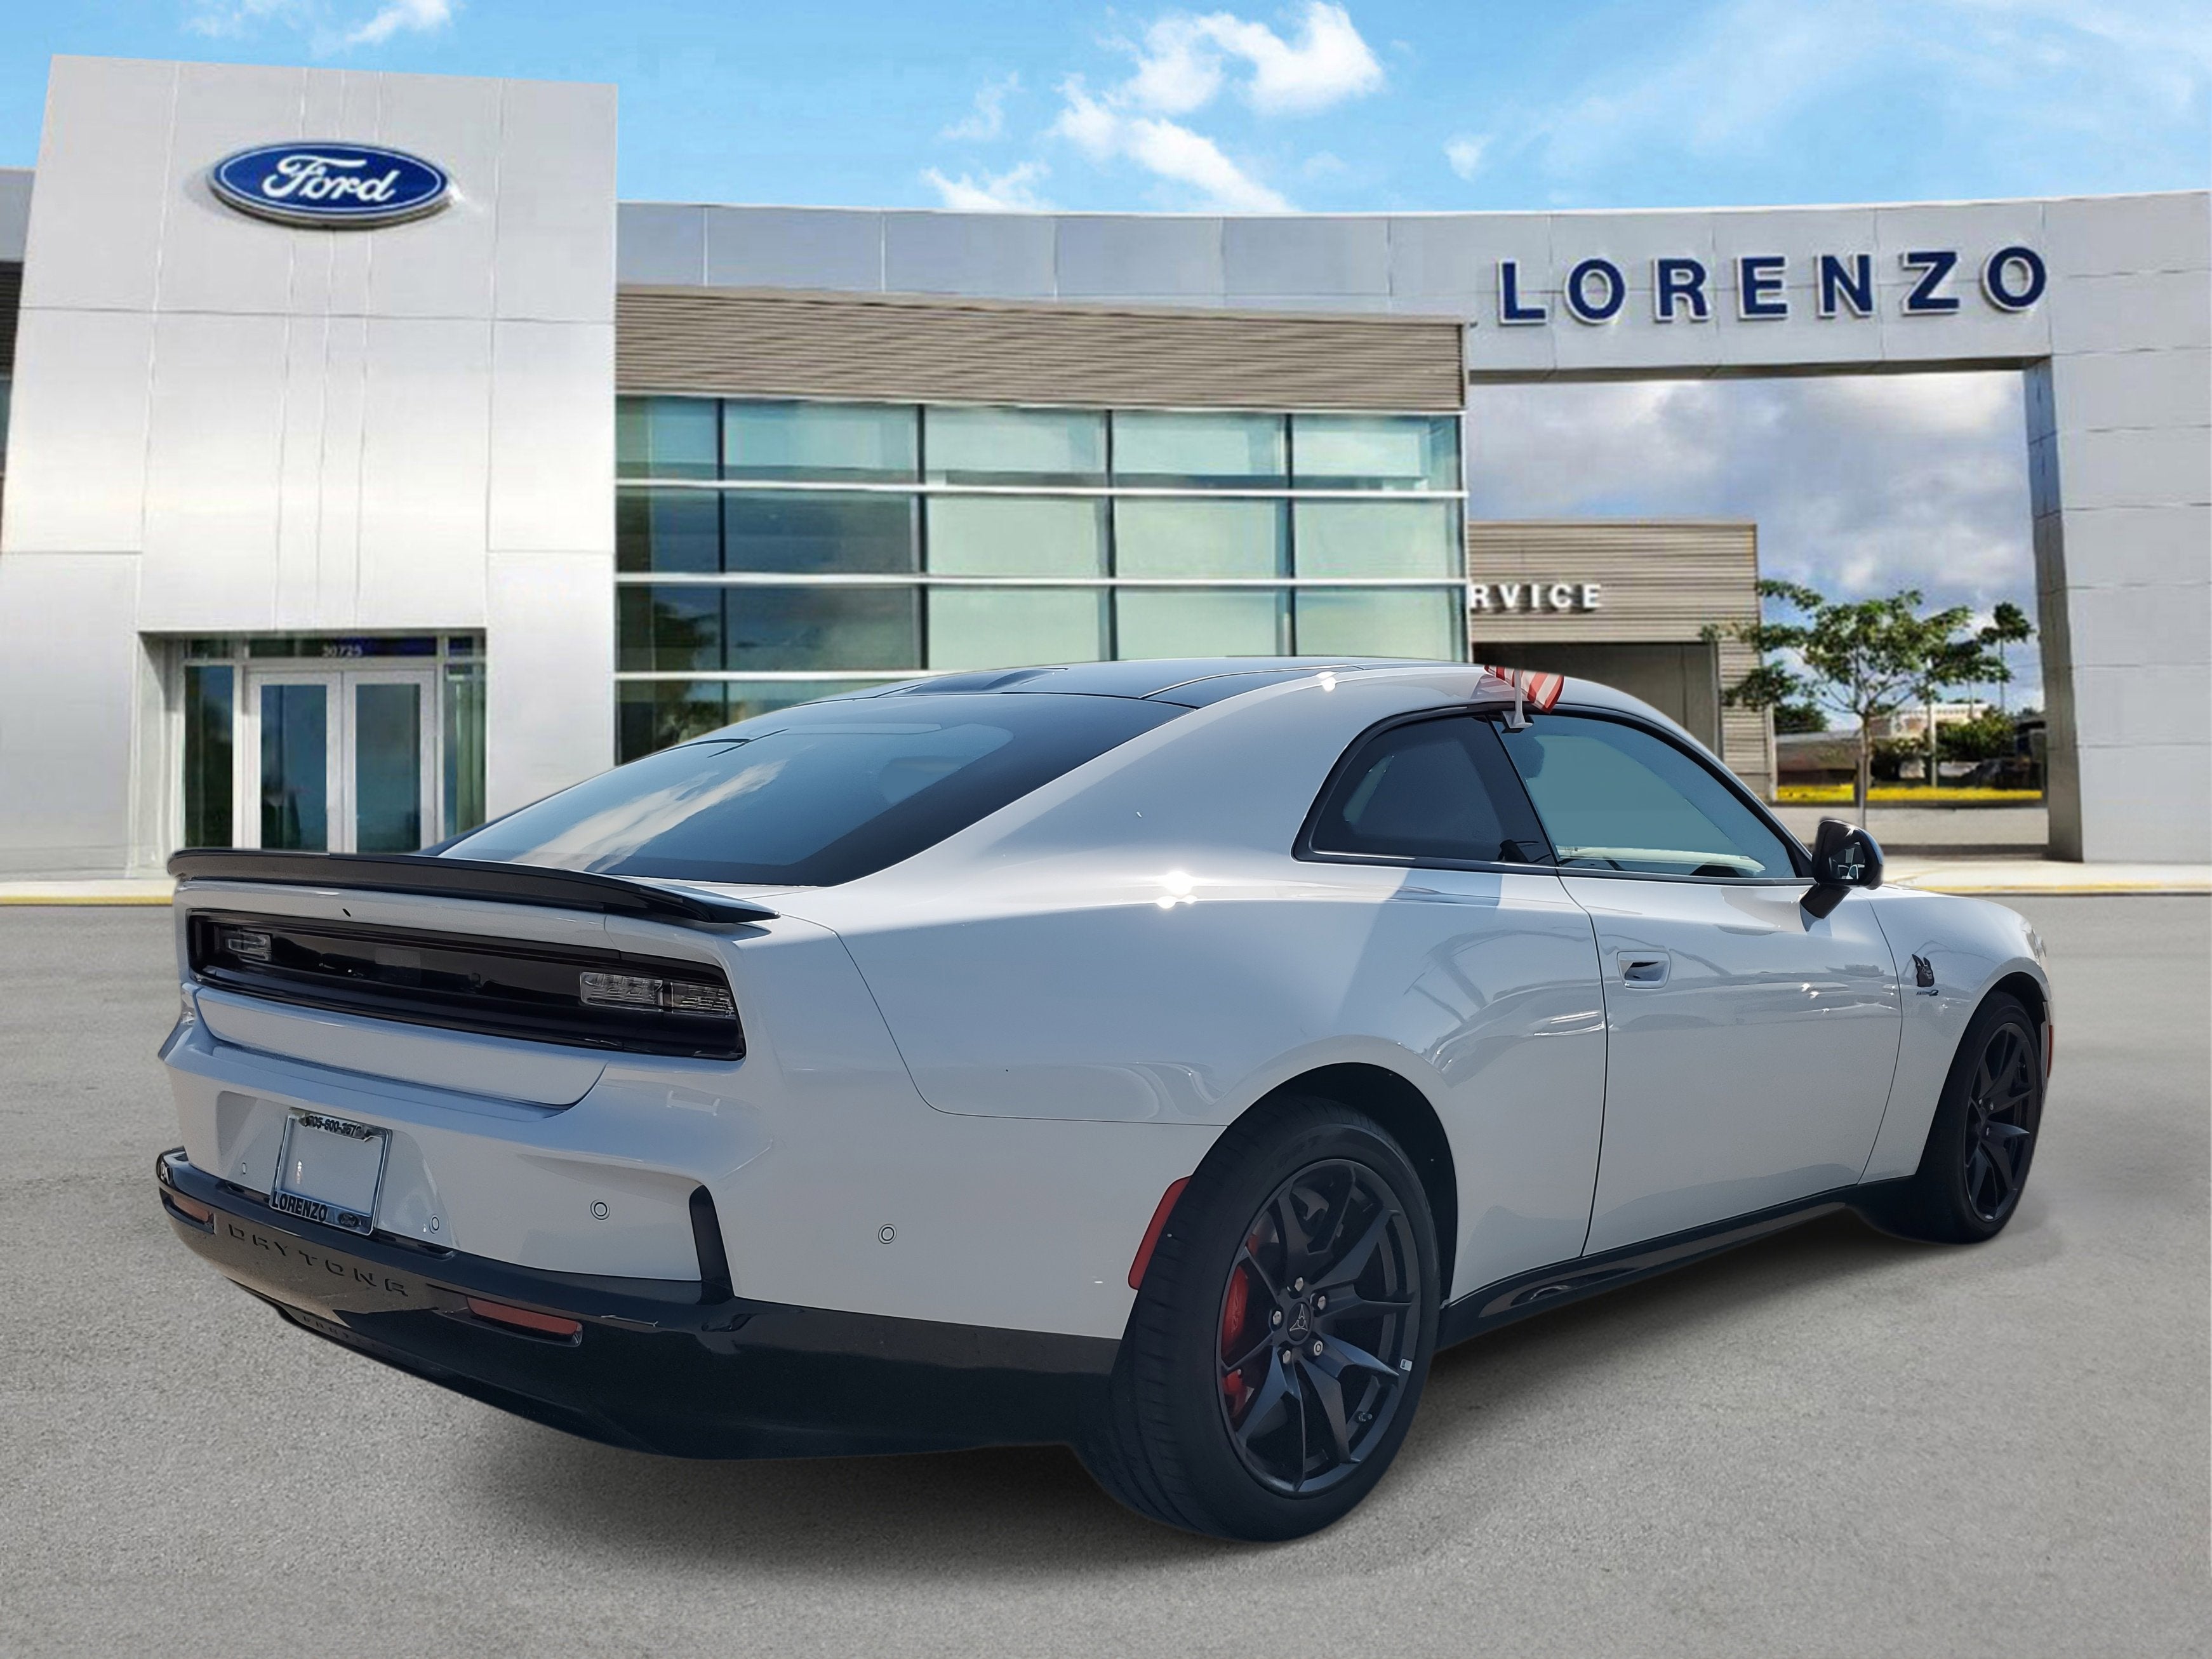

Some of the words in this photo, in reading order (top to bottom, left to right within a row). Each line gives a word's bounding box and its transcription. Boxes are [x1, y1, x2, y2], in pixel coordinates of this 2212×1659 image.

[262, 154, 401, 202] Ford
[1498, 246, 2048, 326] LORENZO
[272, 1191, 328, 1222] LORENZO
[228, 1223, 409, 1297] DAYTONA
